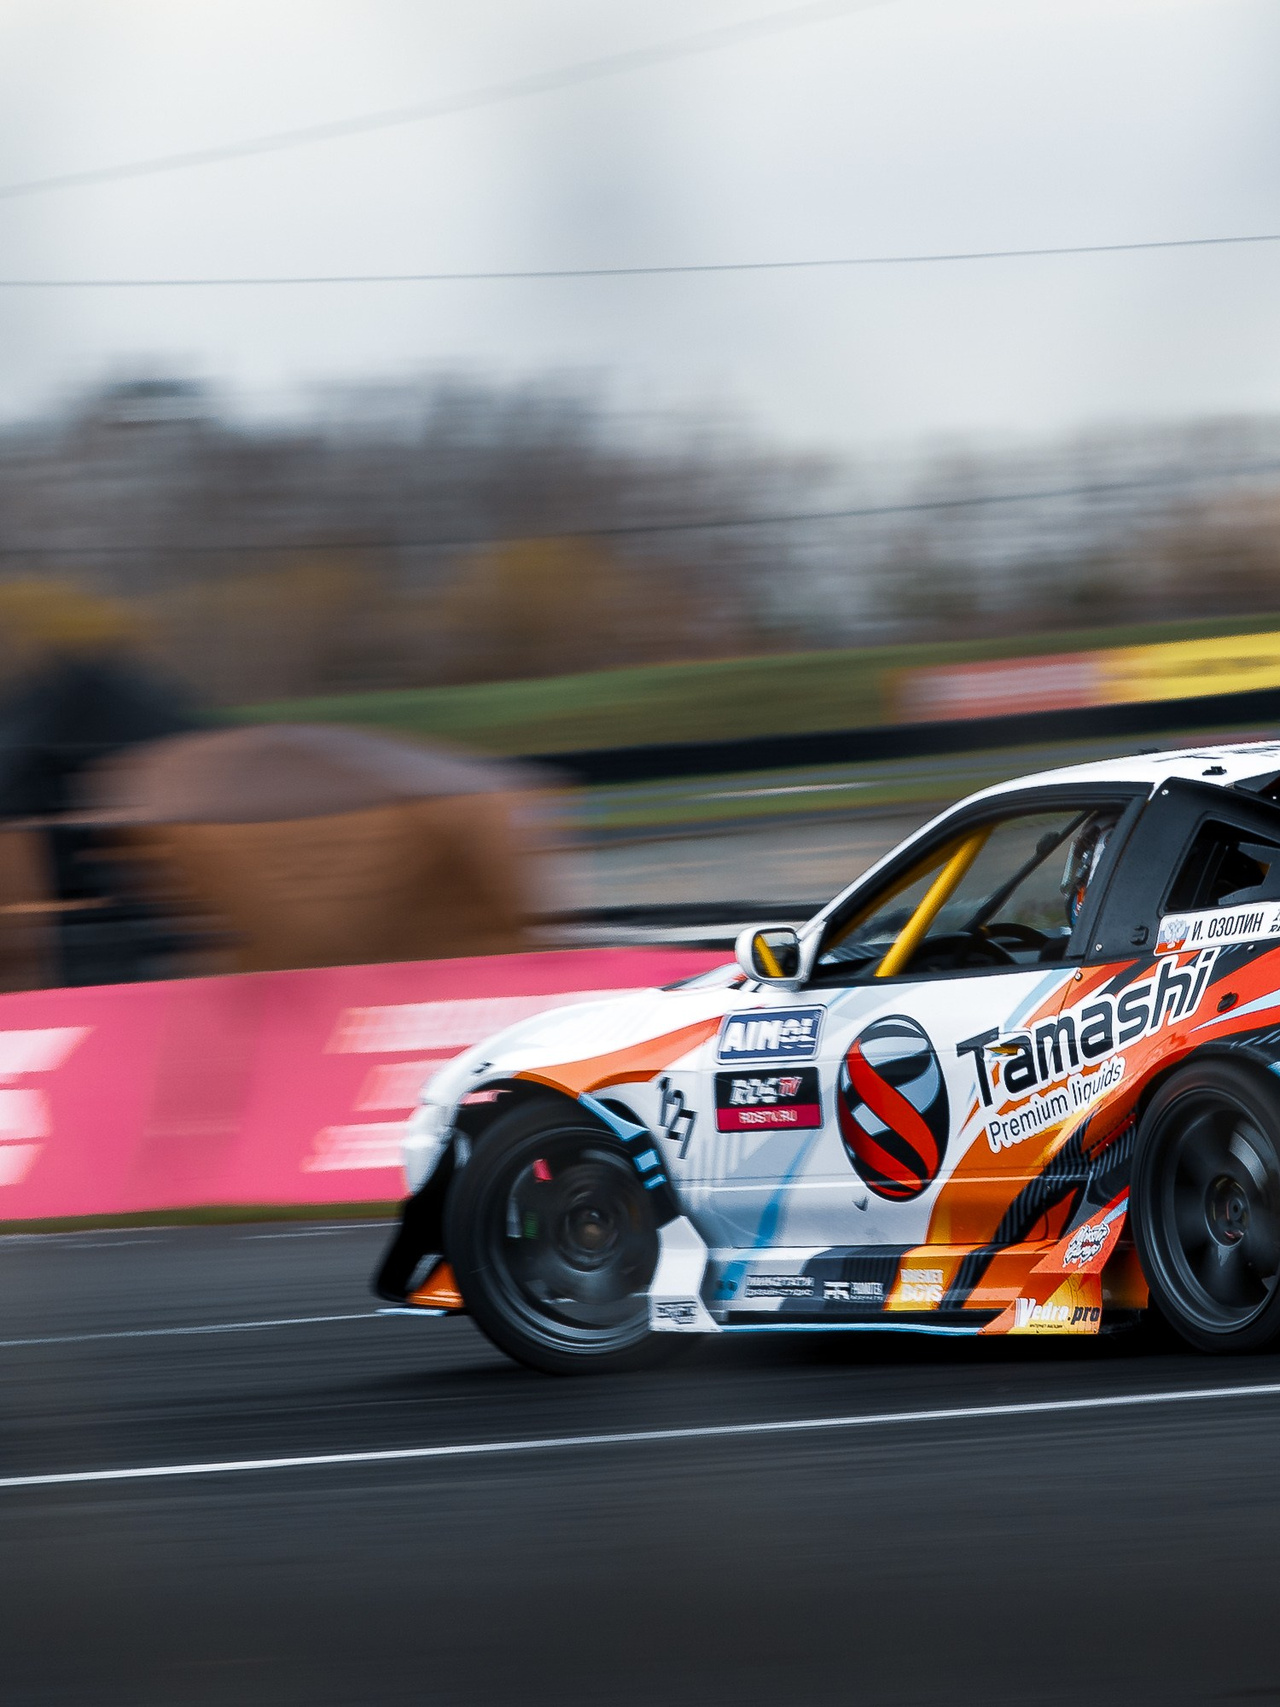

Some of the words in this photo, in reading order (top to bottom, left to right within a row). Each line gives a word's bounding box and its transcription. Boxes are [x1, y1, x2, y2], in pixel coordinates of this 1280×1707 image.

[1191, 919, 1203, 942] И.
[1207, 912, 1265, 939] ОЗОЛИН
[956, 948, 1218, 1109] Tamashi
[658, 1076, 698, 1160] 127
[988, 1094, 1069, 1146] Premium
[1071, 1062, 1122, 1107] liquids
[1014, 1297, 1100, 1328] Vedro.pro
